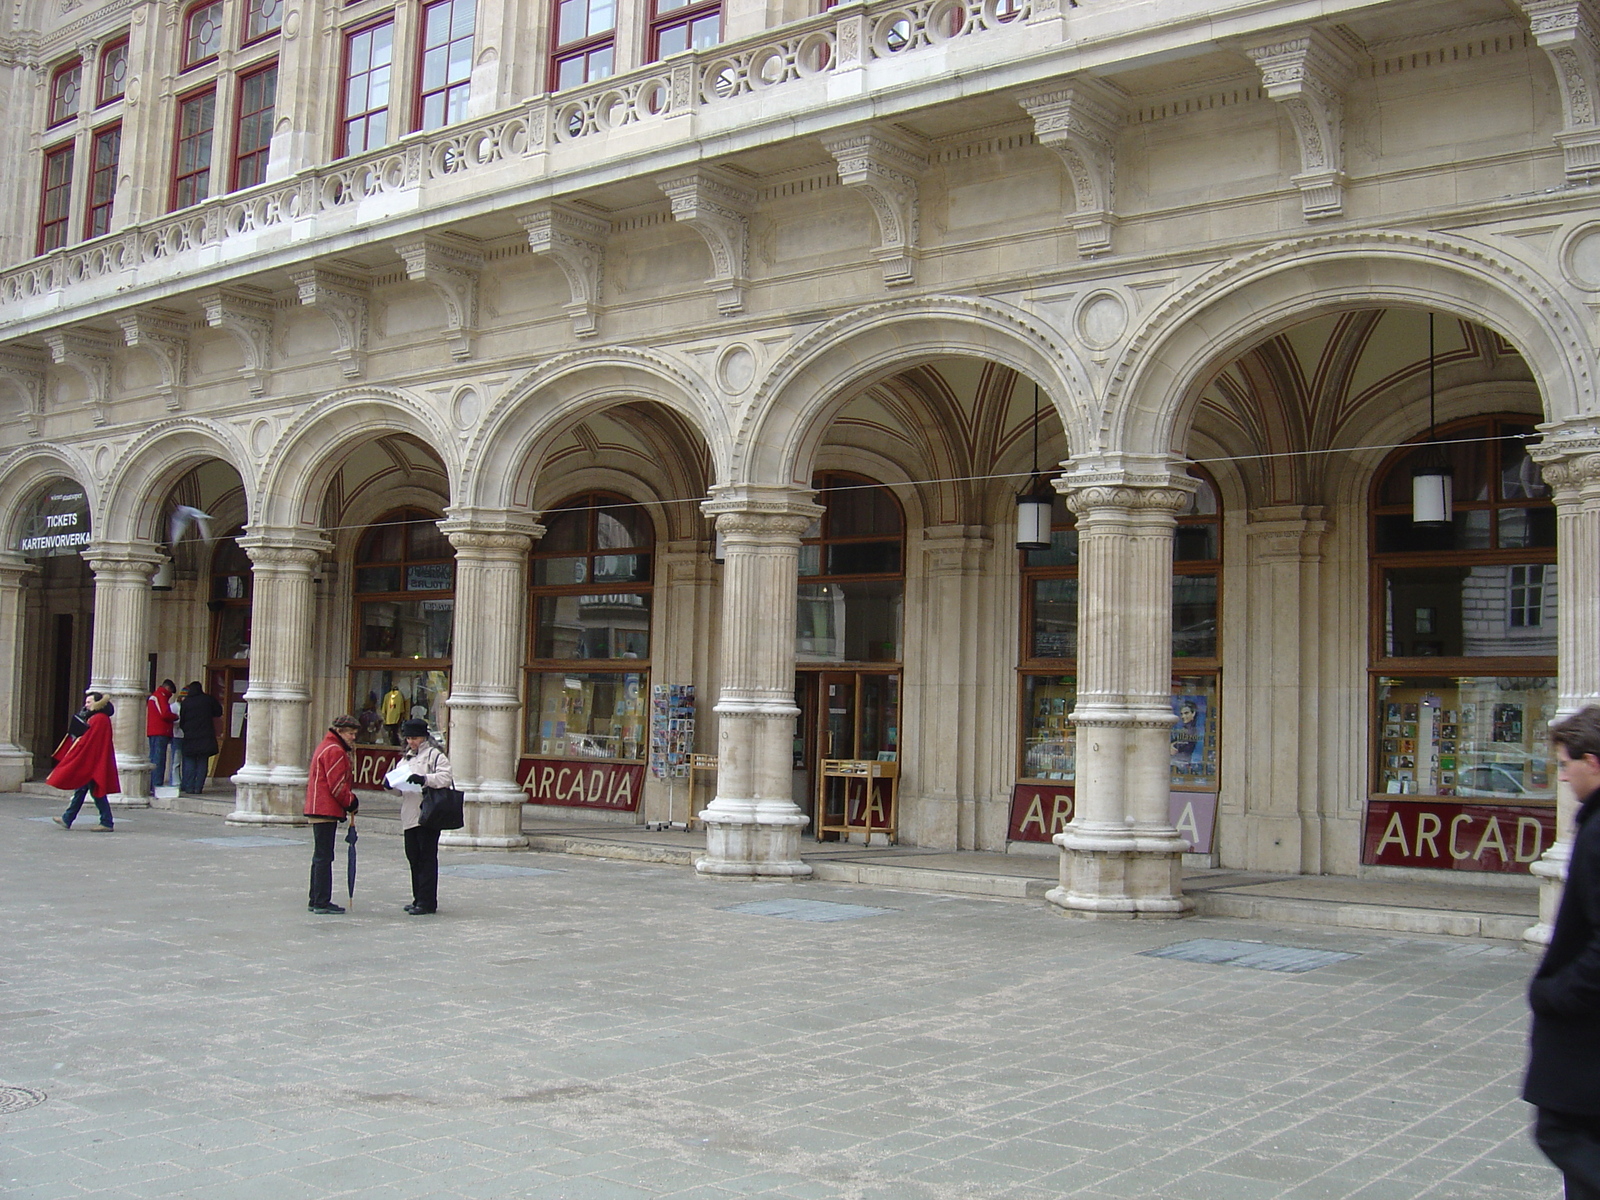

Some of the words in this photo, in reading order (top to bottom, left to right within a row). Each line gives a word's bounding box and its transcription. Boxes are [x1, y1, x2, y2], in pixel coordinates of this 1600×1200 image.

[46, 513, 78, 528] TICKETS
[522, 766, 631, 805] ARCADIA
[1375, 811, 1542, 863] ARCAD
